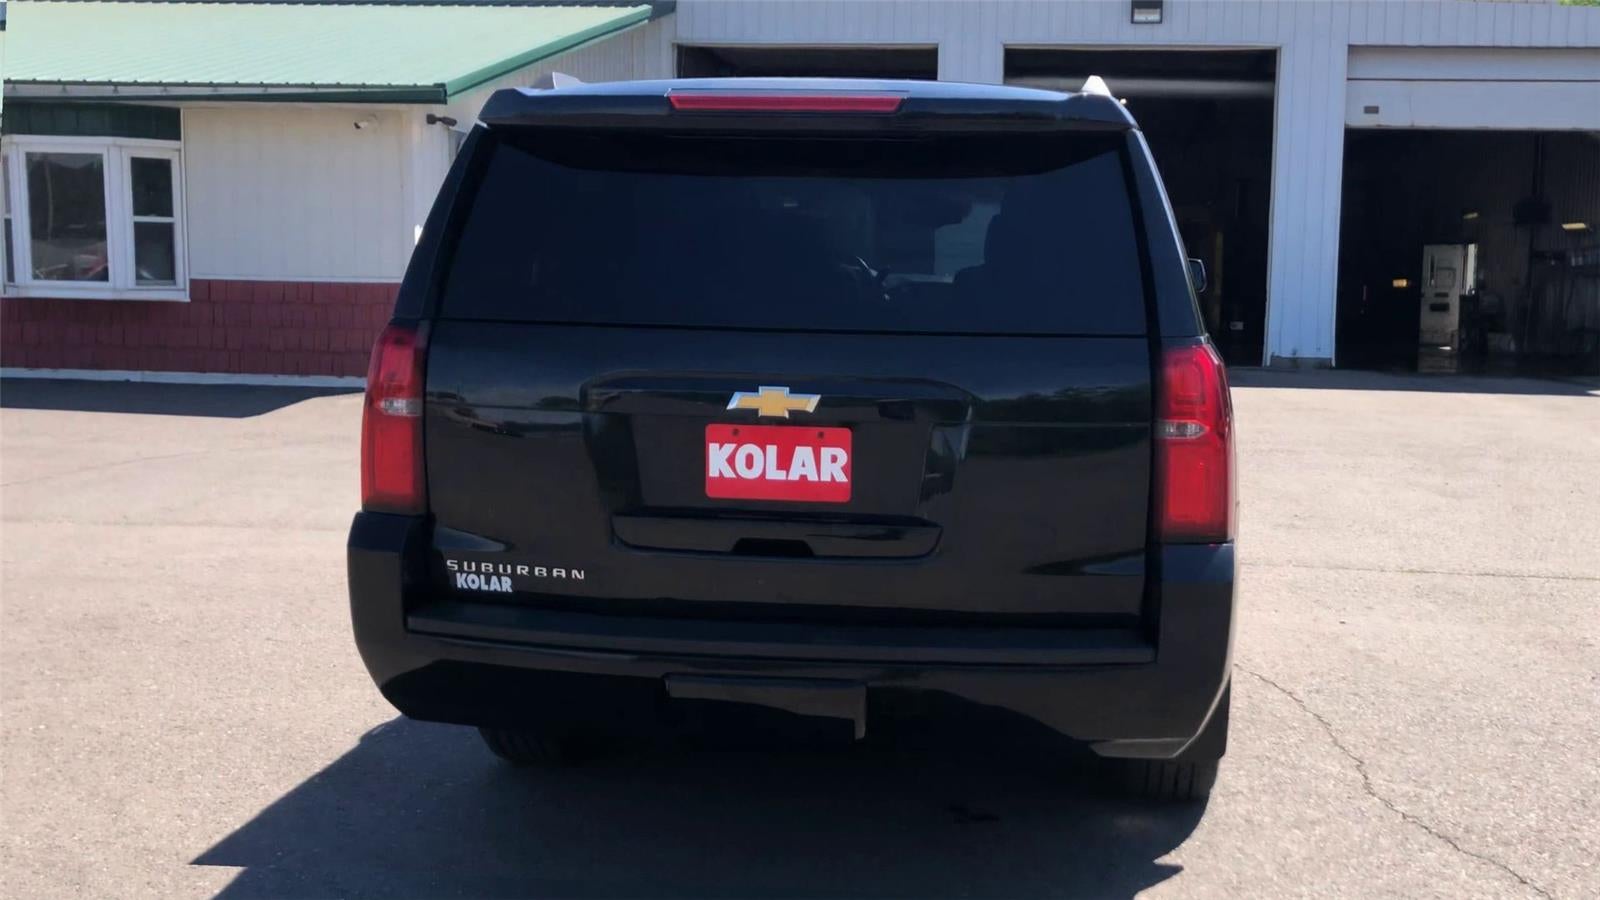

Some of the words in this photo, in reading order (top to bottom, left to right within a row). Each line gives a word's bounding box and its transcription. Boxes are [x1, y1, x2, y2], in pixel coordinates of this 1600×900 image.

[708, 442, 848, 482] KOLAR
[446, 559, 585, 580] SUBURBAN
[456, 572, 513, 593] KOLAR
